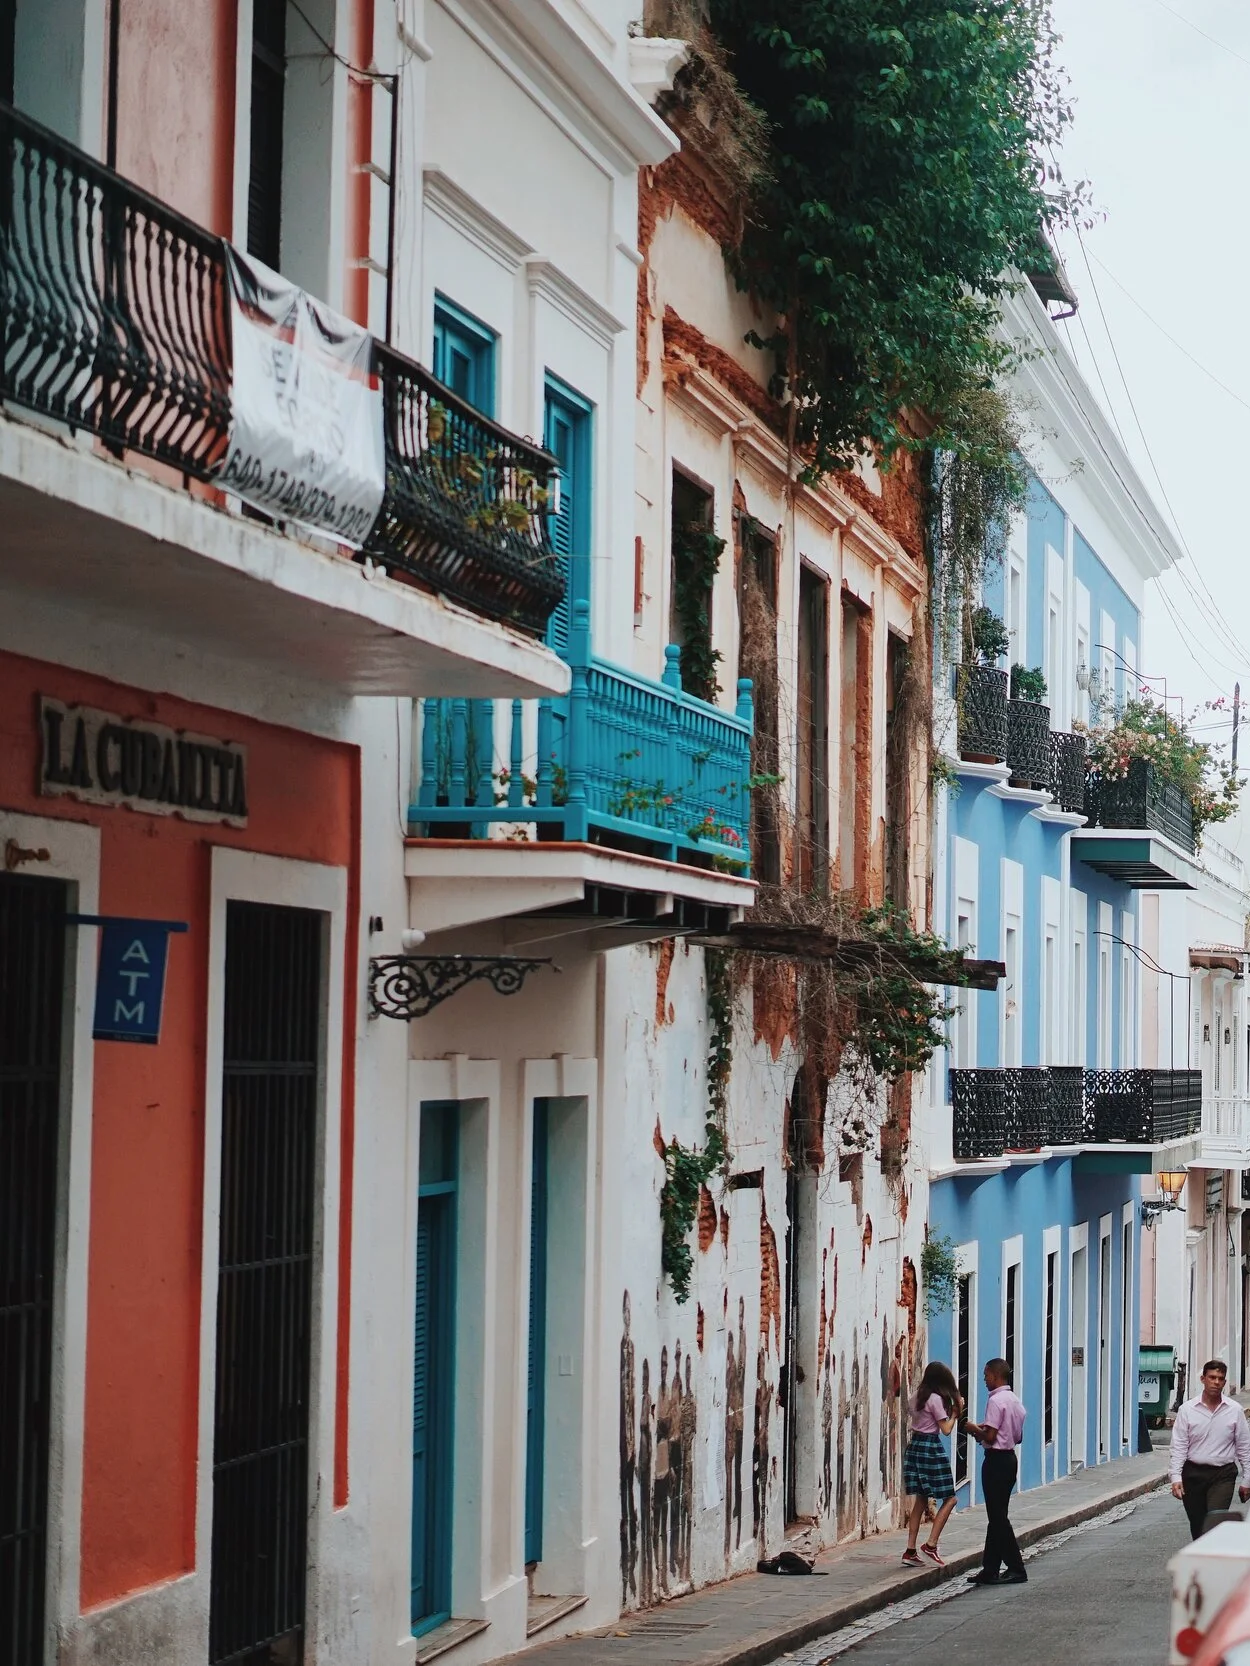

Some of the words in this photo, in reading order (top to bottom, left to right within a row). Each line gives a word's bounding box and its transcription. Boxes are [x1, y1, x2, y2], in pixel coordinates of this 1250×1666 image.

[44, 706, 93, 788] LA
[97, 719, 247, 816] CUBANITA
[114, 939, 150, 1024] ATM
